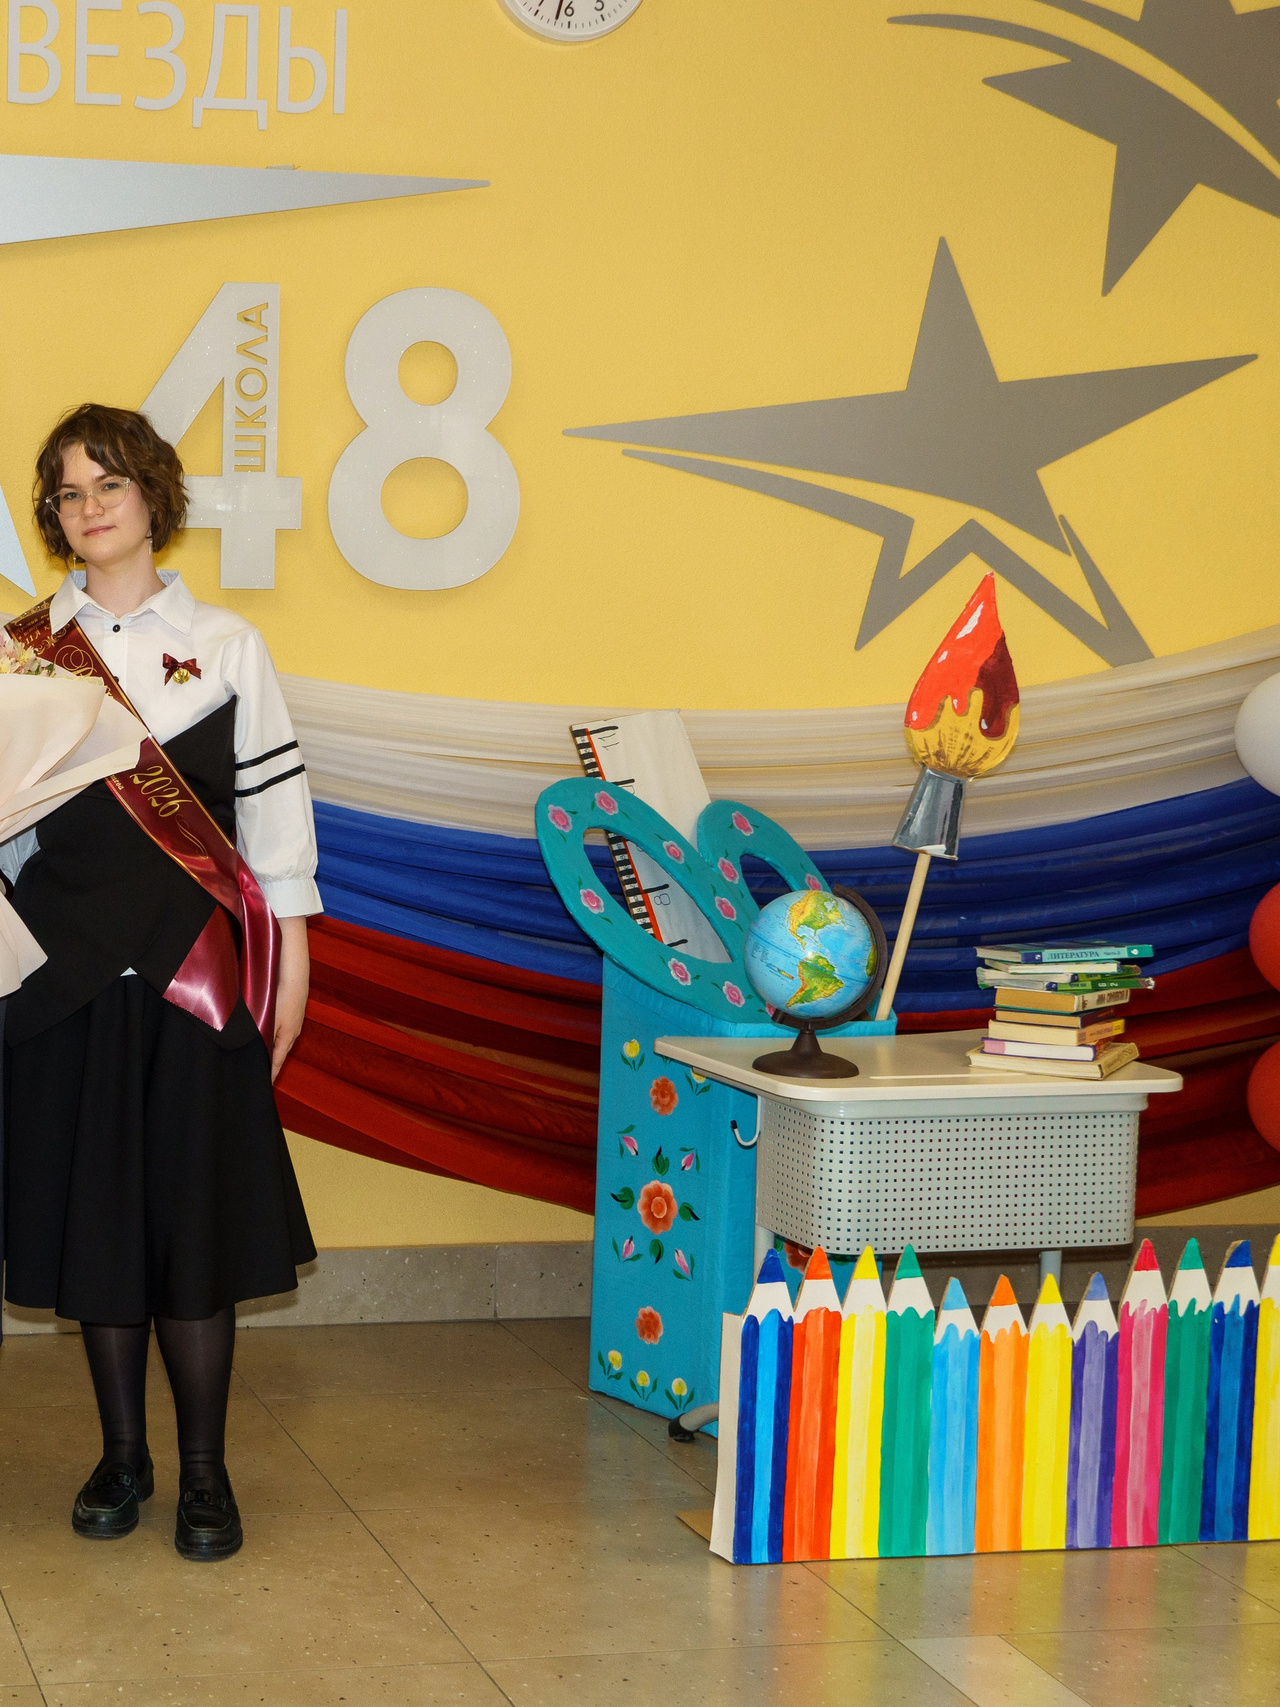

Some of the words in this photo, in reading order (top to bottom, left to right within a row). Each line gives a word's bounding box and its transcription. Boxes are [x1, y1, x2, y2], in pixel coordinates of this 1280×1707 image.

[564, 0, 574, 17] 6
[234, 301, 269, 472] ШКОЛА
[136, 282, 520, 591] 48
[129, 765, 193, 818] 2026
[653, 892, 671, 906] 8
[1047, 951, 1100, 960] ЛИТЕРАТУРА
